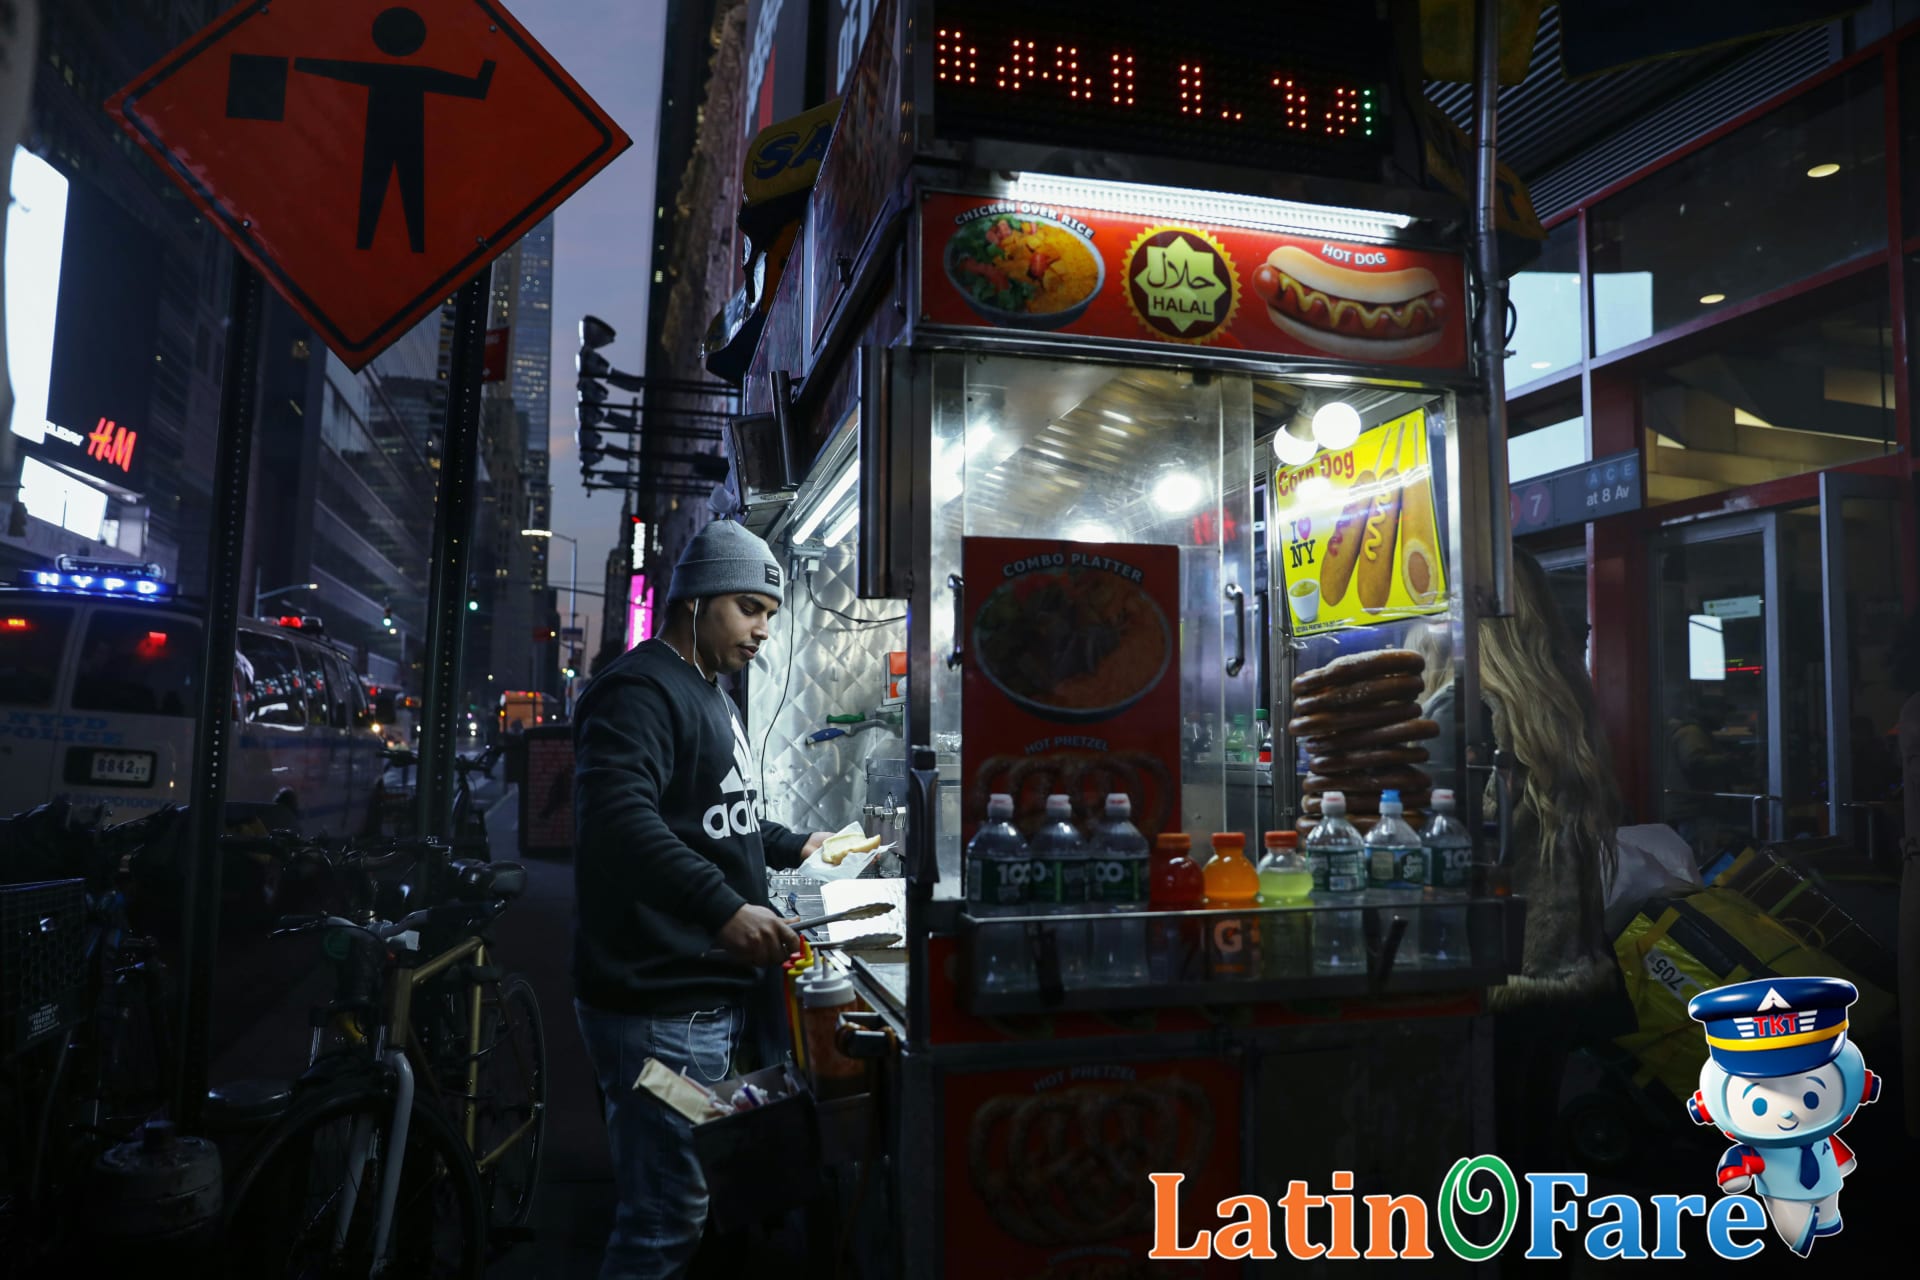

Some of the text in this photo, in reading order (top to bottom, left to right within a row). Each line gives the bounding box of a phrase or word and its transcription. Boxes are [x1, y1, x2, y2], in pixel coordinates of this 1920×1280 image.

[954, 201, 1095, 240] CHICKEN OVER RICE
[1321, 243, 1388, 266] HOT DOG
[1146, 251, 1216, 290] حلال
[1153, 295, 1213, 316] HALAL
[87, 416, 138, 473] H&M
[1278, 450, 1355, 497] Corn Dog
[1606, 467, 1616, 481] C
[1623, 463, 1633, 477] E
[1530, 493, 1543, 517] 7
[1586, 484, 1630, 507] at 8 Av
[1290, 520, 1299, 545] I
[1290, 539, 1316, 569] NY
[1002, 552, 1144, 584] COMBO PLATTER
[37, 571, 159, 595] NYPD
[1023, 735, 1051, 756] HOT
[1213, 918, 1243, 953] G
[1652, 958, 1685, 991] 705
